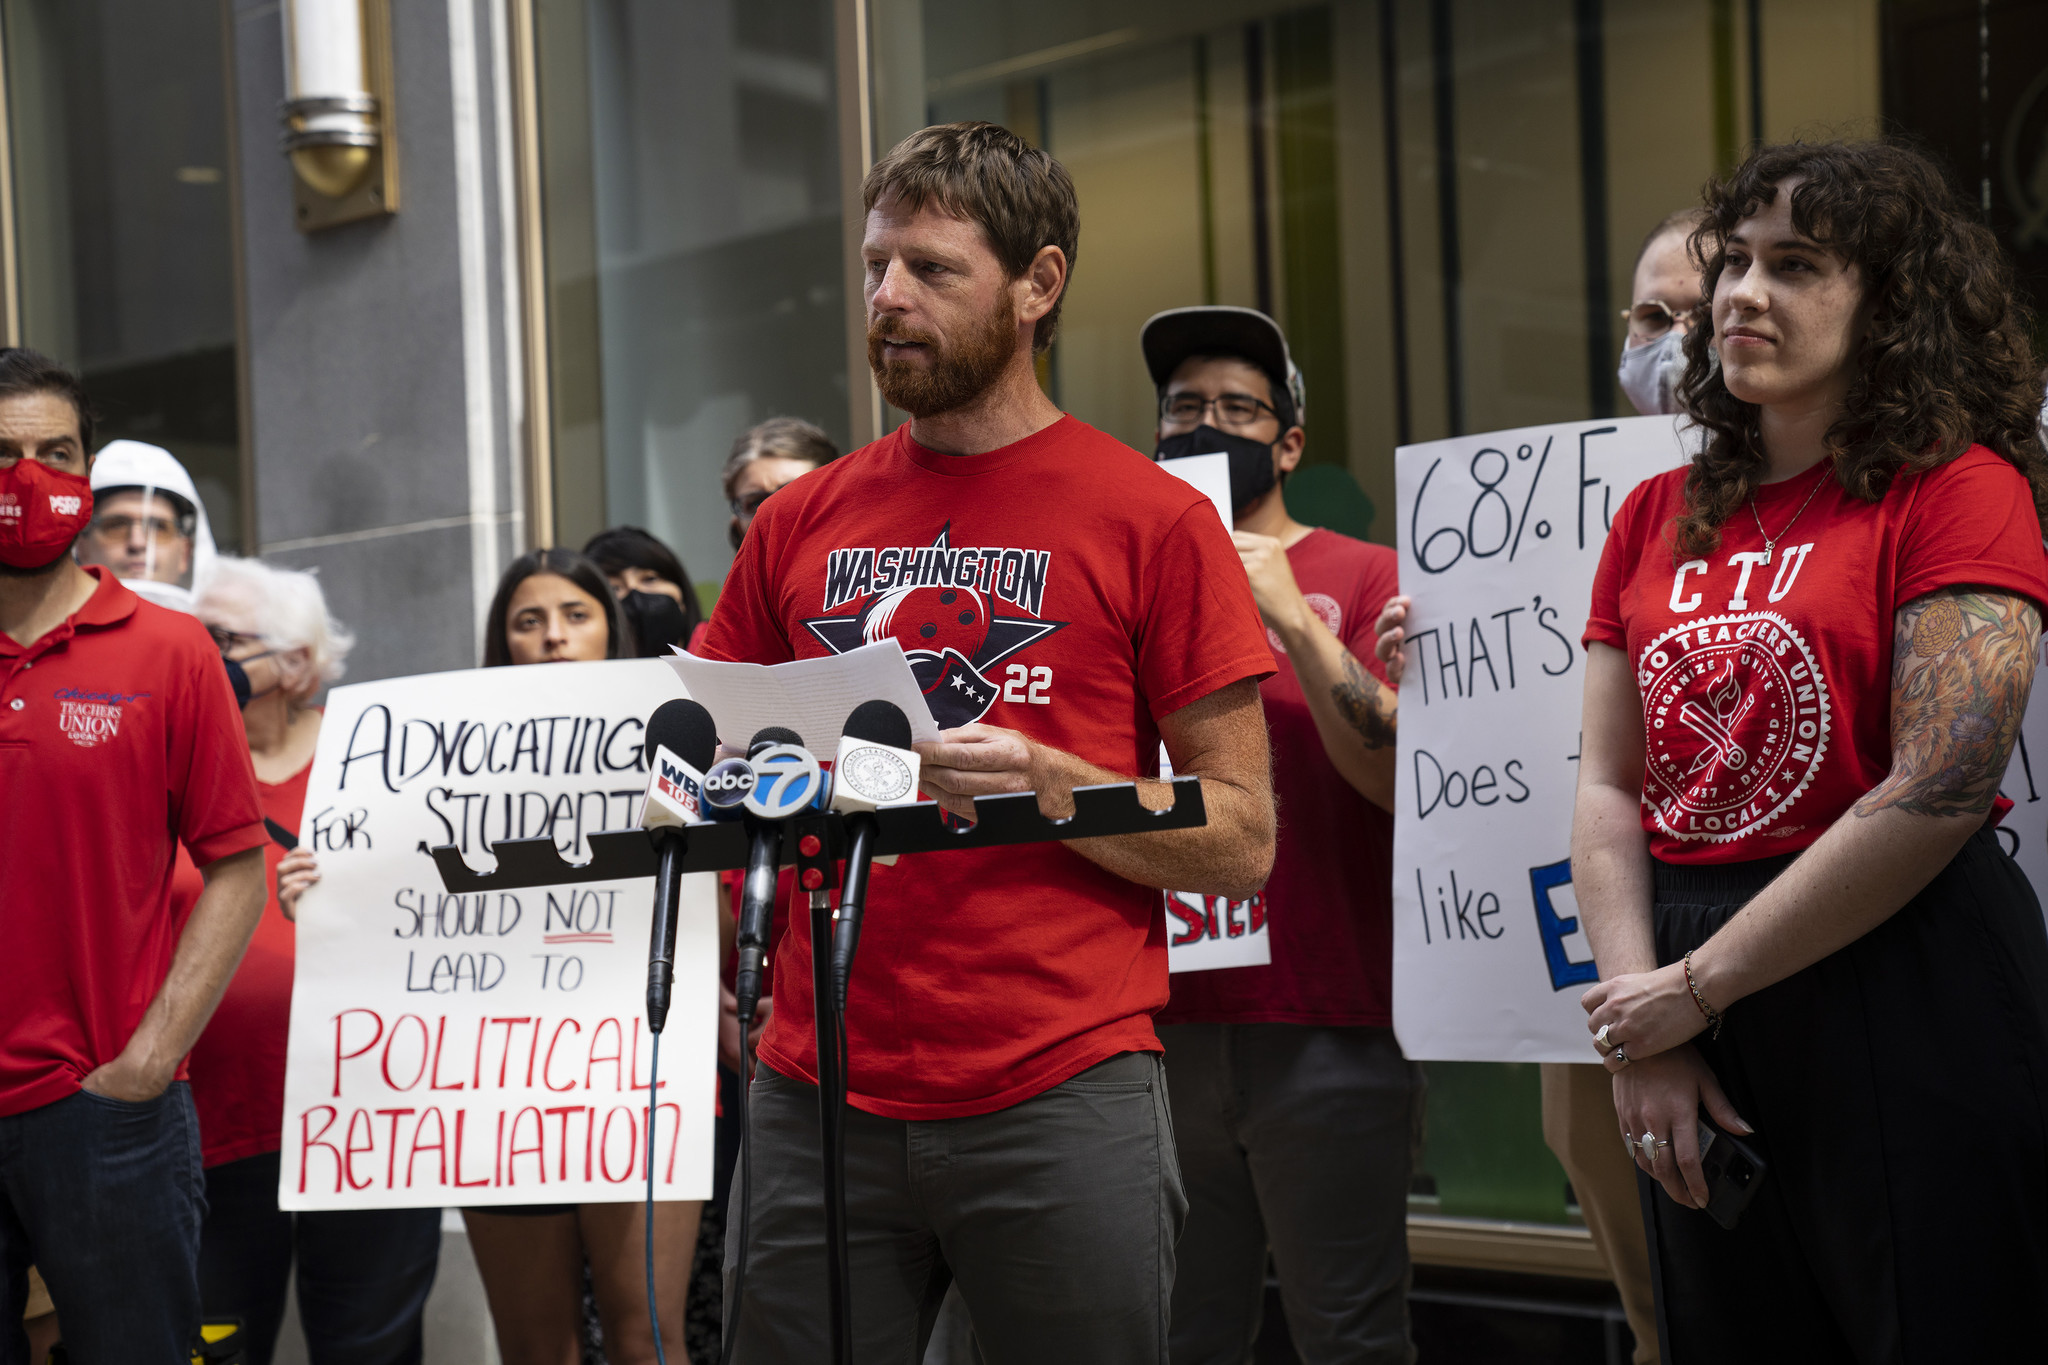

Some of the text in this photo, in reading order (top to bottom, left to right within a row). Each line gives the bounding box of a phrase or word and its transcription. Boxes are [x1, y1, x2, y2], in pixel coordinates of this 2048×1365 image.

[1411, 434, 1554, 575] 68%
[822, 546, 1052, 619] WASHINGTON
[1668, 542, 1815, 614] CTU
[1003, 663, 1053, 705] 22
[1404, 595, 1574, 707] THAT'S
[59, 713, 120, 737] UNION
[60, 701, 123, 719] TEACHERS
[1653, 653, 1780, 786] ORGANIZE UNITE DEFEND
[1675, 621, 1792, 657] TEACHERS
[1789, 660, 1818, 764] UNION
[67, 731, 98, 742] LOCAL
[338, 703, 647, 793] ADVOCATING
[704, 769, 754, 791] abc
[1413, 749, 1531, 821] Does
[1660, 796, 1685, 826] AFT
[1688, 801, 1763, 831] LOCAL
[1765, 785, 1782, 804] 1
[1688, 784, 1718, 799] 1937
[311, 806, 373, 853] FOR
[394, 887, 625, 940] SHOULD NOT
[1416, 867, 1504, 945] like
[531, 952, 584, 992] TO
[330, 1007, 667, 1098] POLITICAL
[297, 1102, 682, 1194] RETALIATION
